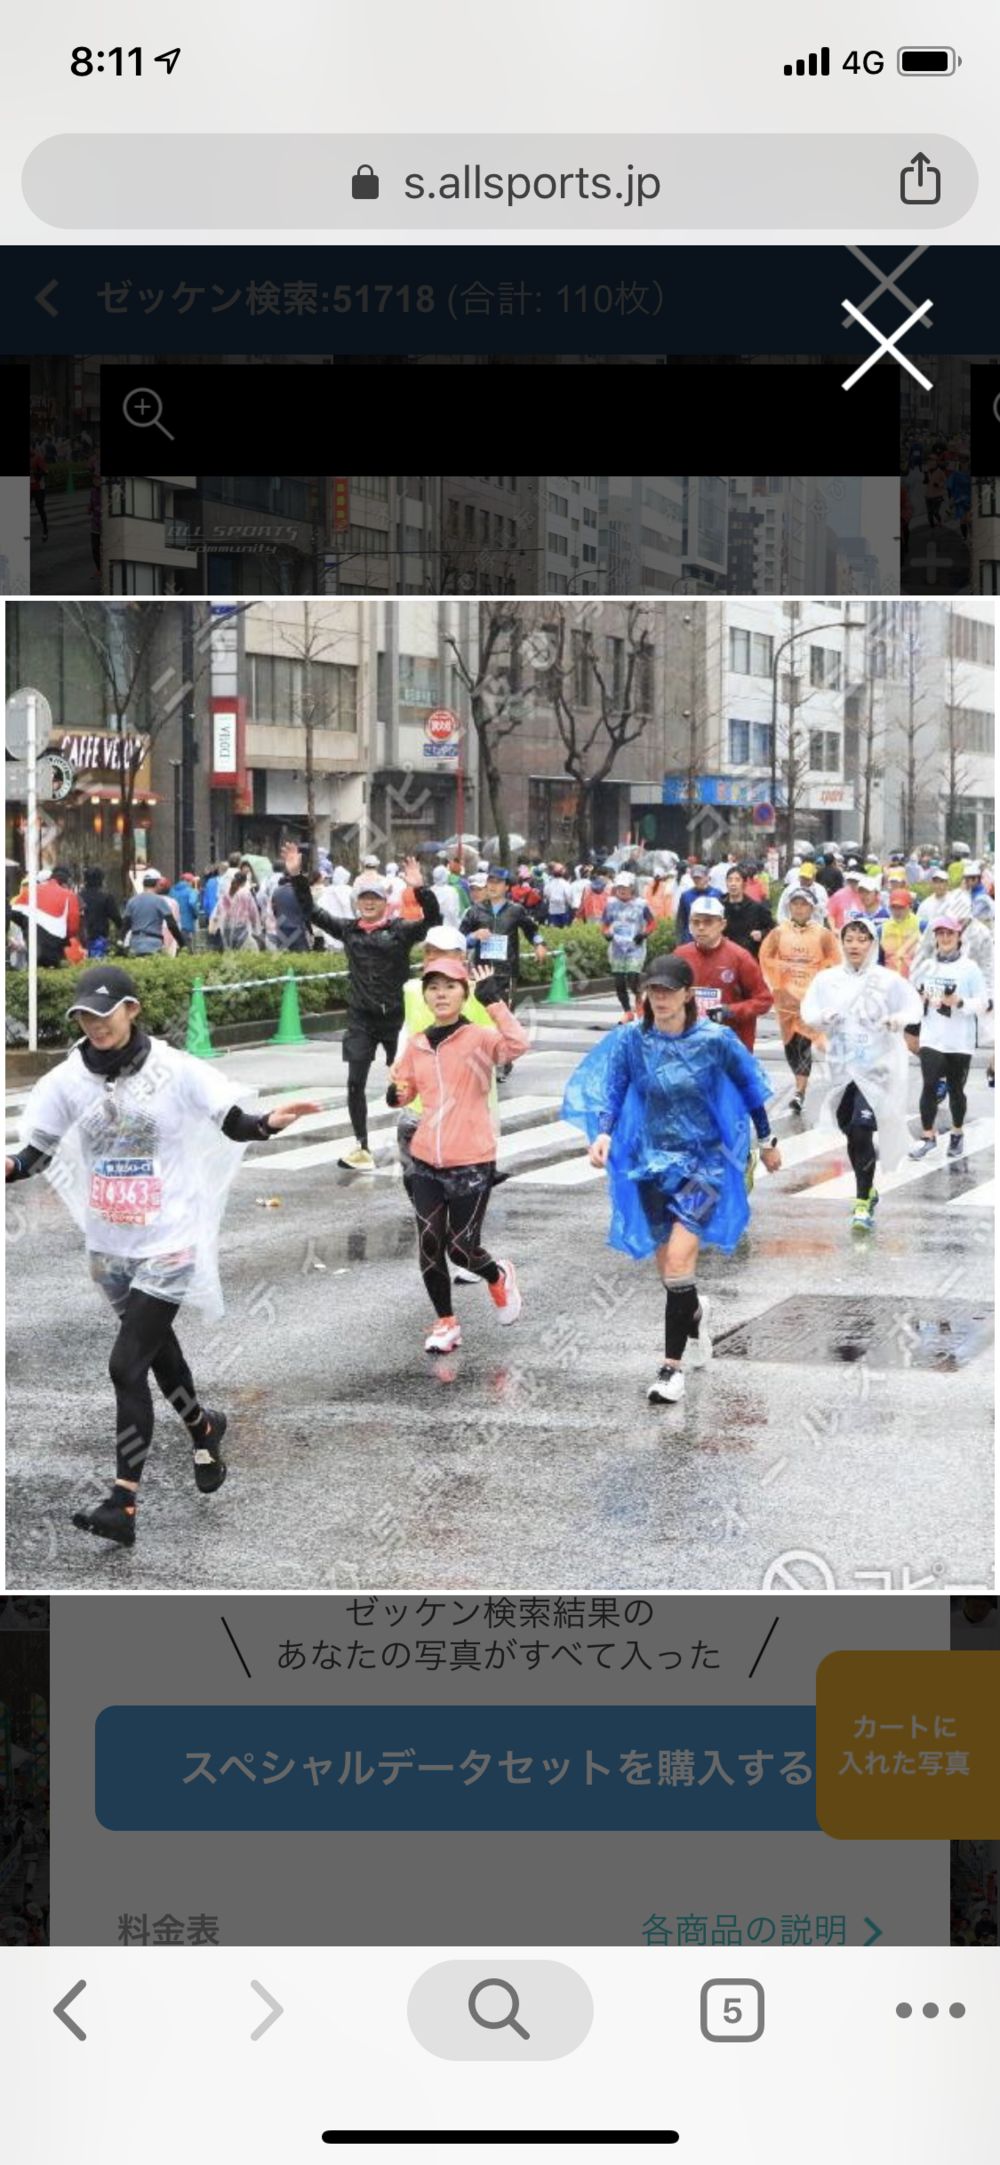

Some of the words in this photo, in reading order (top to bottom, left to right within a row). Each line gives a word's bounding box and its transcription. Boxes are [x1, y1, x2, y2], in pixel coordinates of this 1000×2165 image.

[71, 46, 142, 77] 8:11
[842, 50, 884, 75] 4G
[405, 164, 660, 207] s.allsports.jp
[97, 279, 434, 316] ゼッケン検索:51718
[61, 735, 101, 769] CAFFE
[346, 1596, 653, 1628] ゼッケン検索結果の
[278, 1638, 719, 1672] あなたの写真がすべて入った
[854, 1715, 956, 1739] カートに
[183, 1748, 812, 1787] スペシャルデータセットを購入する
[838, 1750, 970, 1776] 入れた写真
[118, 1914, 219, 1946] 料金表
[642, 1913, 845, 1946] 各商品の説明
[724, 1998, 742, 2024] 5
